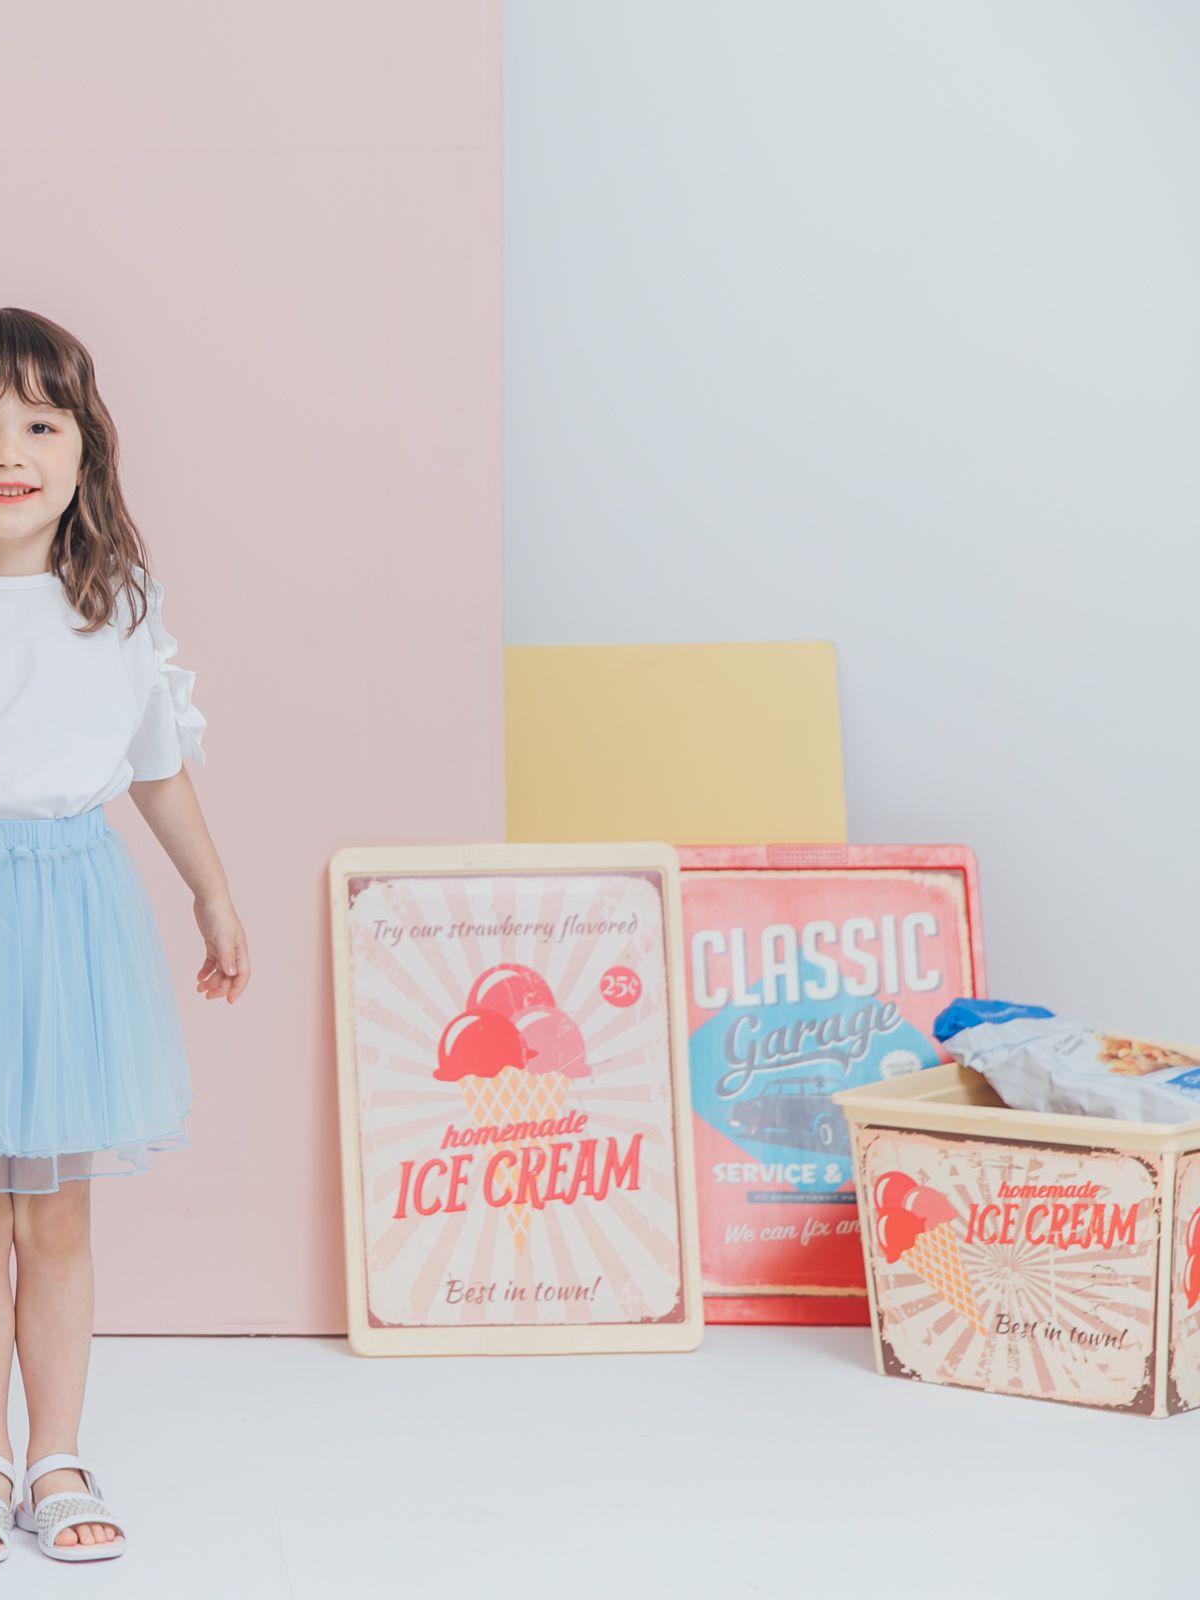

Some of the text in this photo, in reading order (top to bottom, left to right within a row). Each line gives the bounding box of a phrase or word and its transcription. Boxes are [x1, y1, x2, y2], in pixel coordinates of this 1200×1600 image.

[372, 912, 640, 947] Try our strawberry flavored
[690, 911, 942, 1010] CLASSIC
[601, 974, 641, 998] 25¢
[715, 1002, 904, 1099] Garage
[441, 1108, 589, 1150] homemade
[391, 1133, 645, 1219] ICE CREAM
[712, 1162, 843, 1185] SERVICE &
[996, 1180, 1102, 1199] homemade
[725, 1223, 755, 1244] We
[759, 1222, 798, 1240] can
[801, 1217, 832, 1247] fix
[964, 1203, 1140, 1250] ICE CREAM
[445, 1275, 603, 1305] Best in town!
[995, 1314, 1129, 1350] Best in town!
